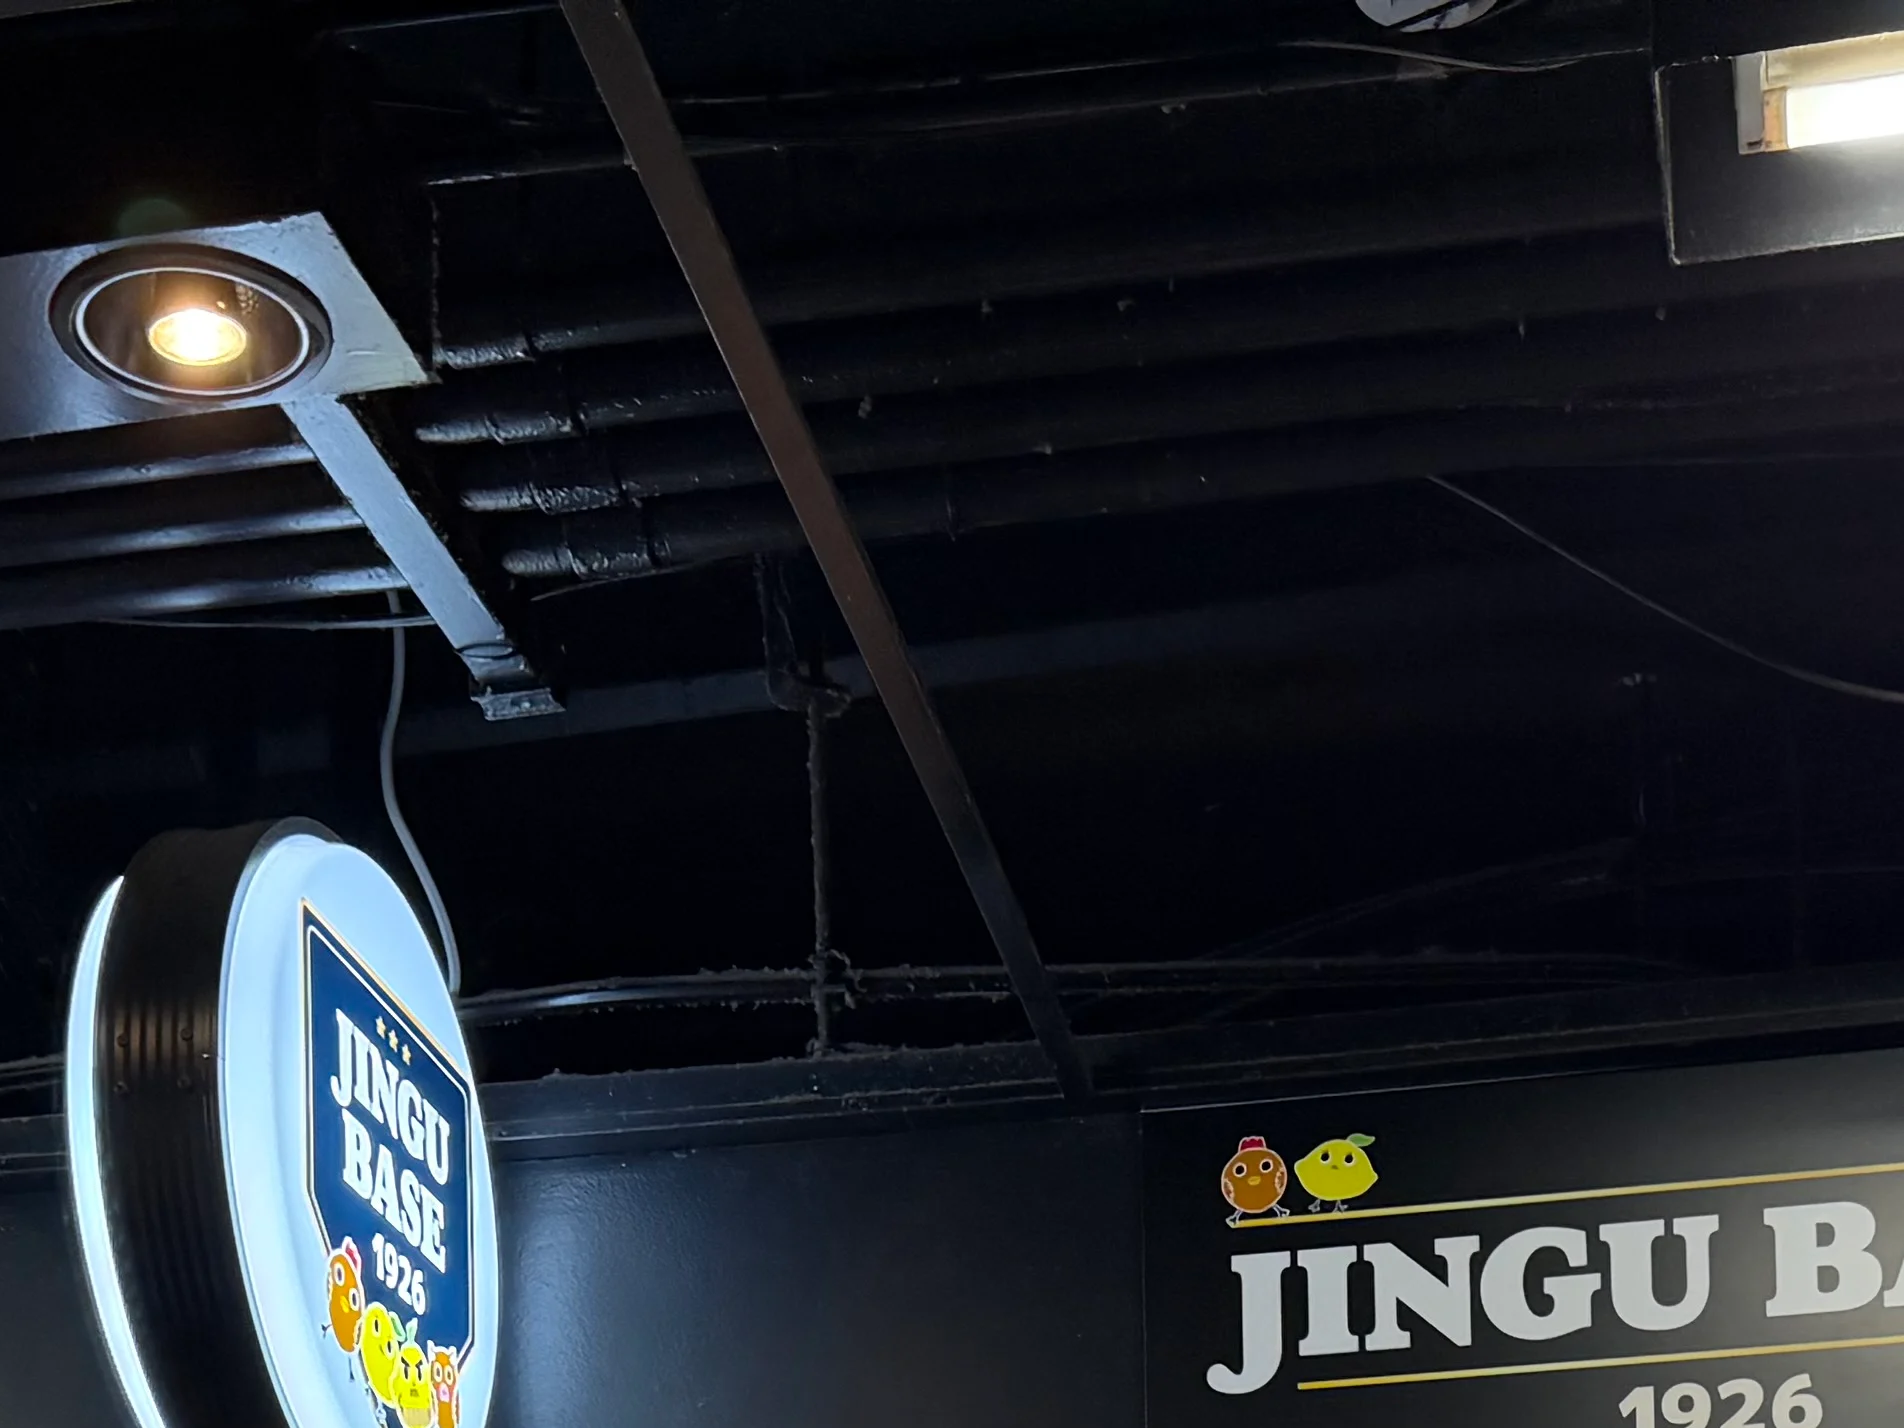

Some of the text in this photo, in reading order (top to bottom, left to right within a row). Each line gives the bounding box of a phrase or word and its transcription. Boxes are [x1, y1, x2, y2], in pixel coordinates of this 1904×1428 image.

[330, 1009, 450, 1185] JINGU
[342, 1108, 446, 1272] BASE
[372, 1233, 426, 1314] 1926
[1206, 1215, 1719, 1396] JINGU
